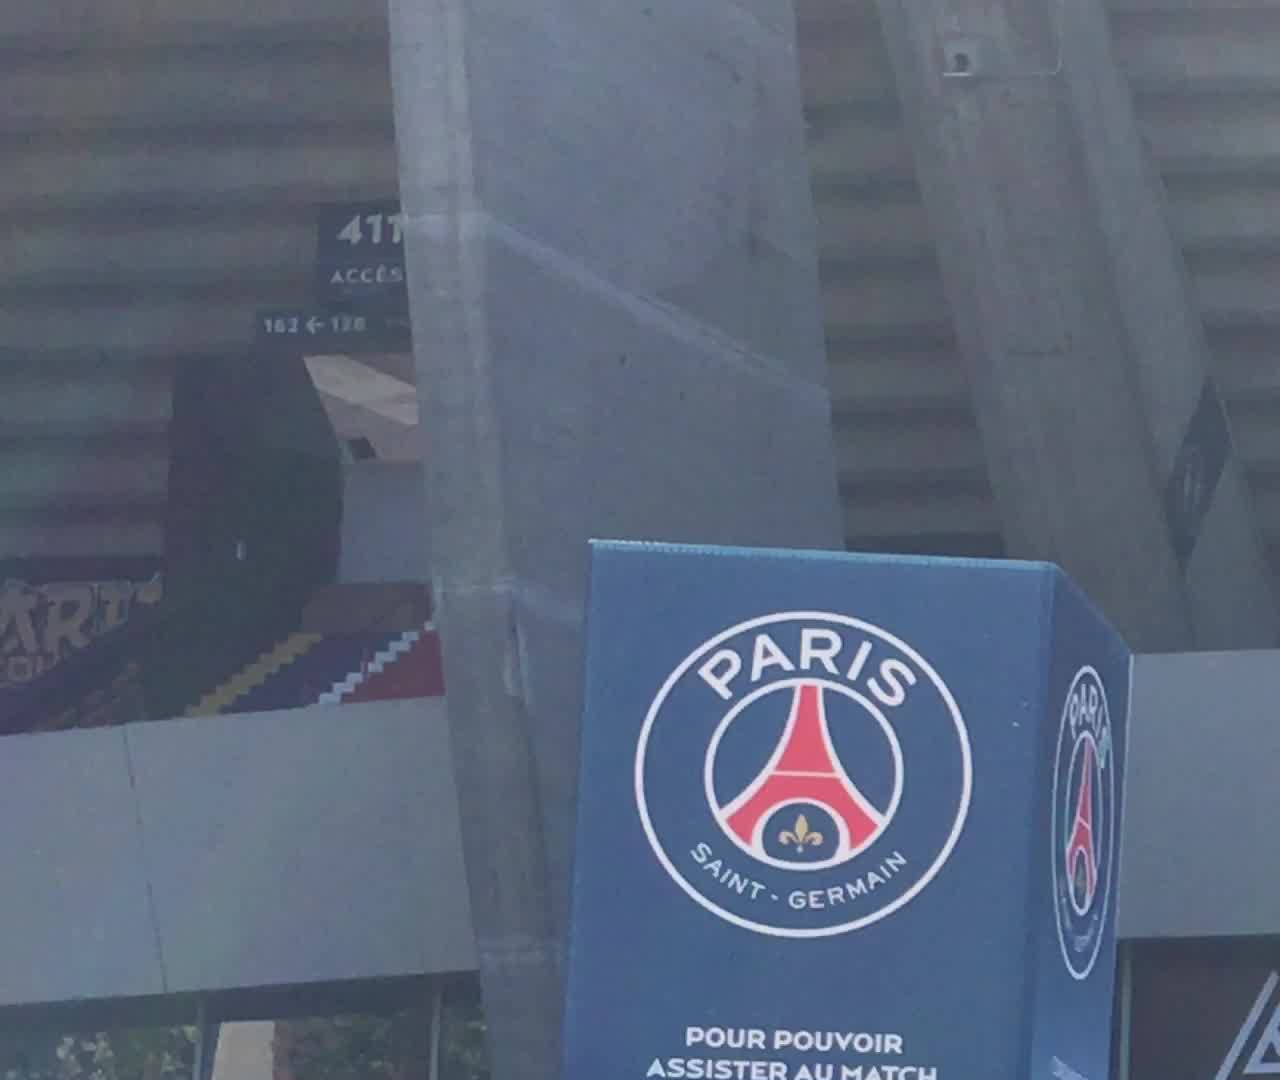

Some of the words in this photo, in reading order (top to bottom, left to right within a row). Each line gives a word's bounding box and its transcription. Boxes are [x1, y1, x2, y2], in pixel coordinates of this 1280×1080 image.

[698, 628, 917, 707] PARIS
[690, 843, 766, 902] SAINT
[789, 851, 908, 910] GERMAIN
[686, 1027, 765, 1049] POUR
[774, 1030, 903, 1054] POUVOIR
[647, 1058, 787, 1080] ASSISTER
